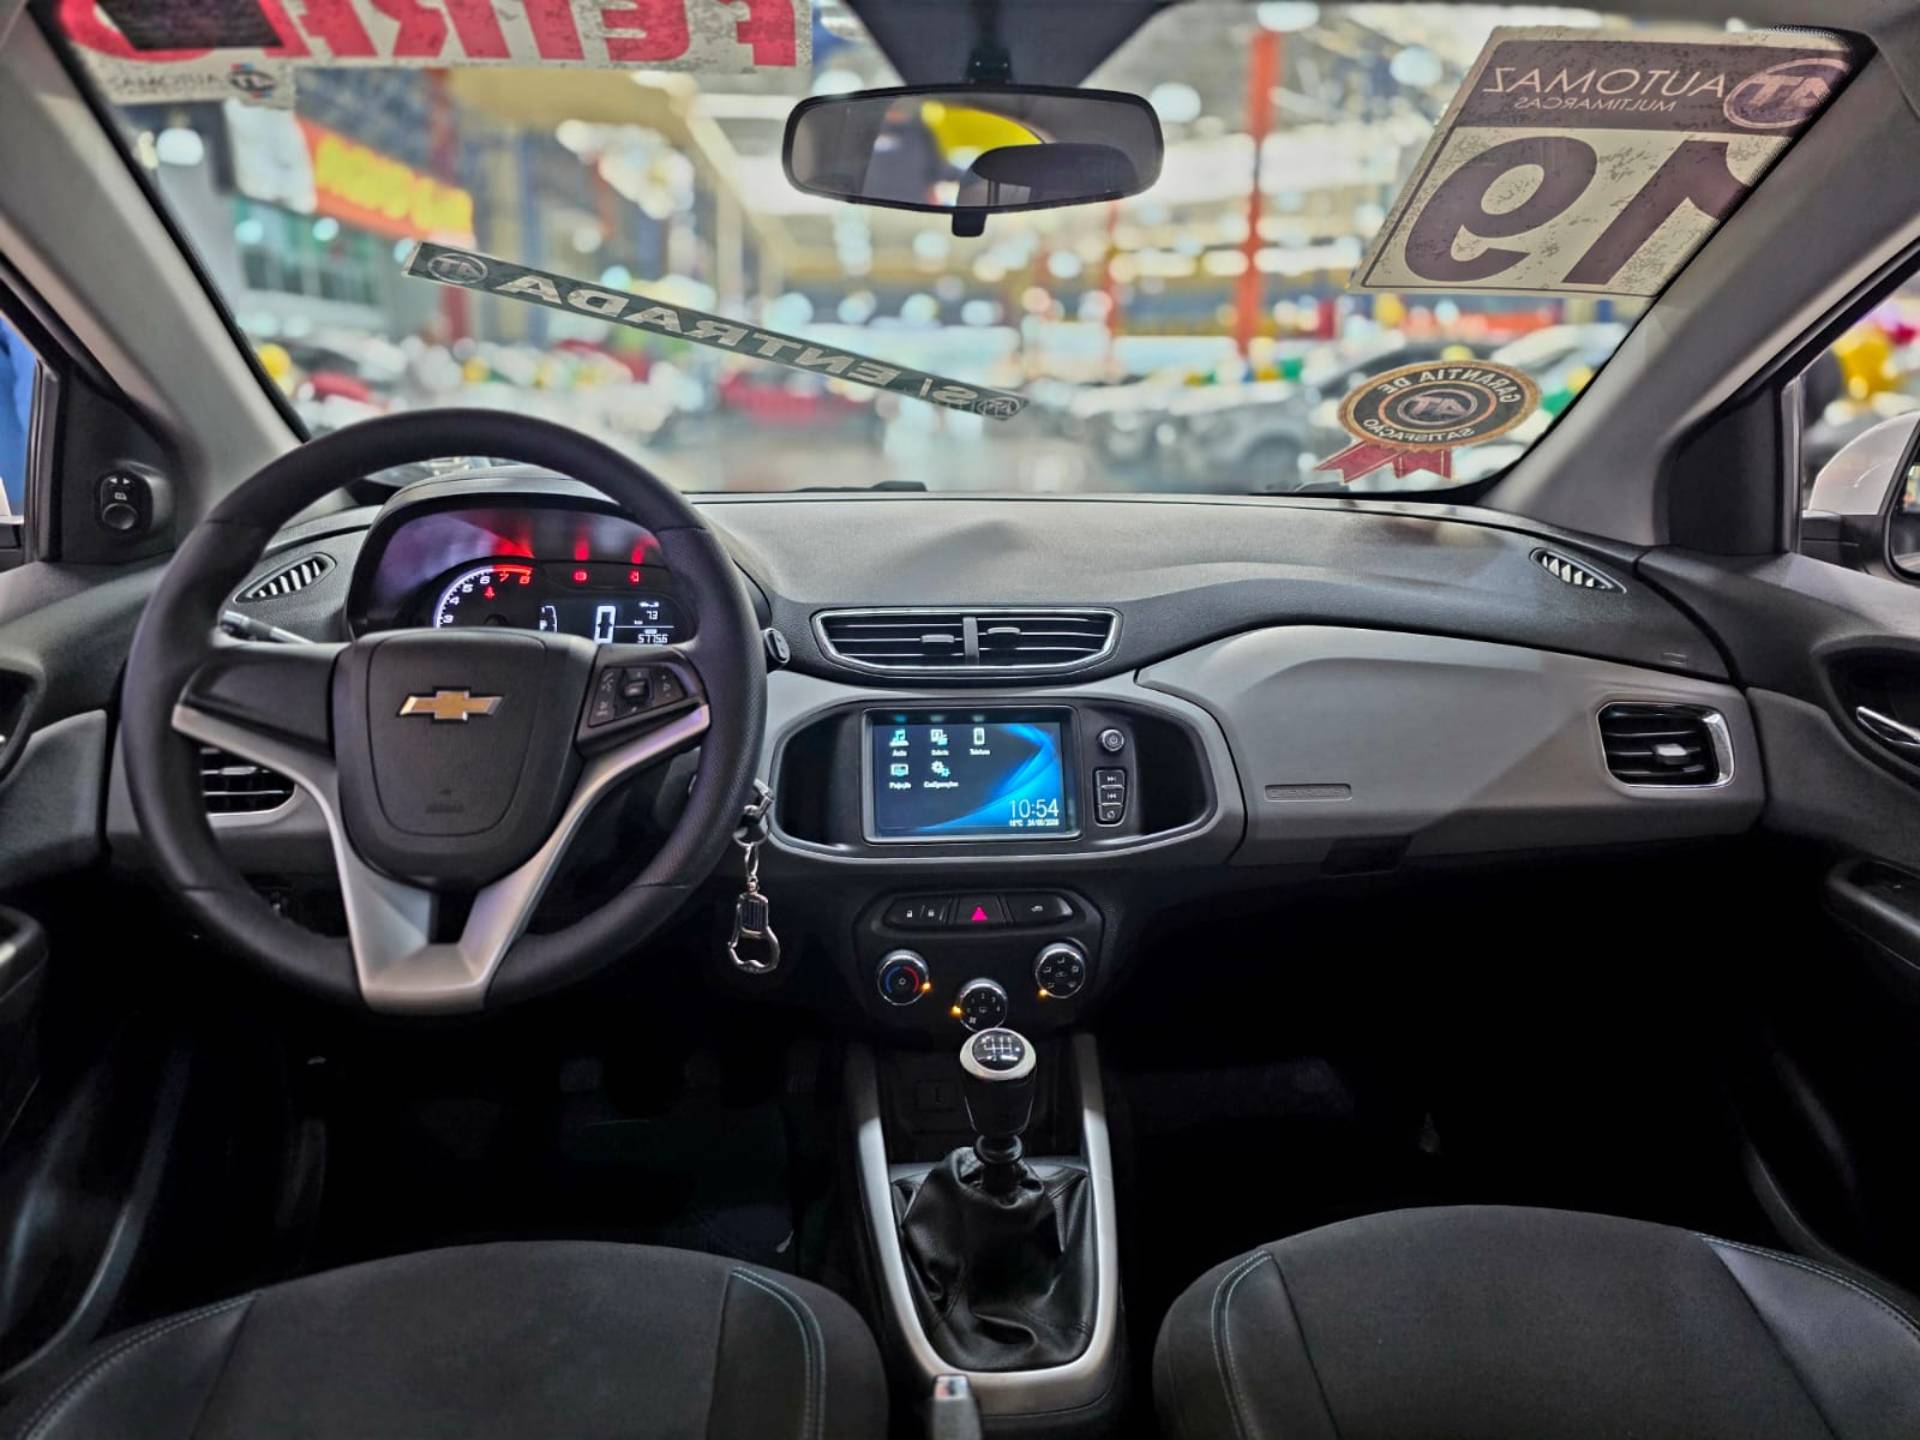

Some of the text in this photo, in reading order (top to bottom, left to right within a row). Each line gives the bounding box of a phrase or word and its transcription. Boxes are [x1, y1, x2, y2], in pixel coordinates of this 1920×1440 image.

[462, 583, 474, 593] 5
[449, 596, 460, 605] 4
[1009, 797, 1060, 819] 10:54
